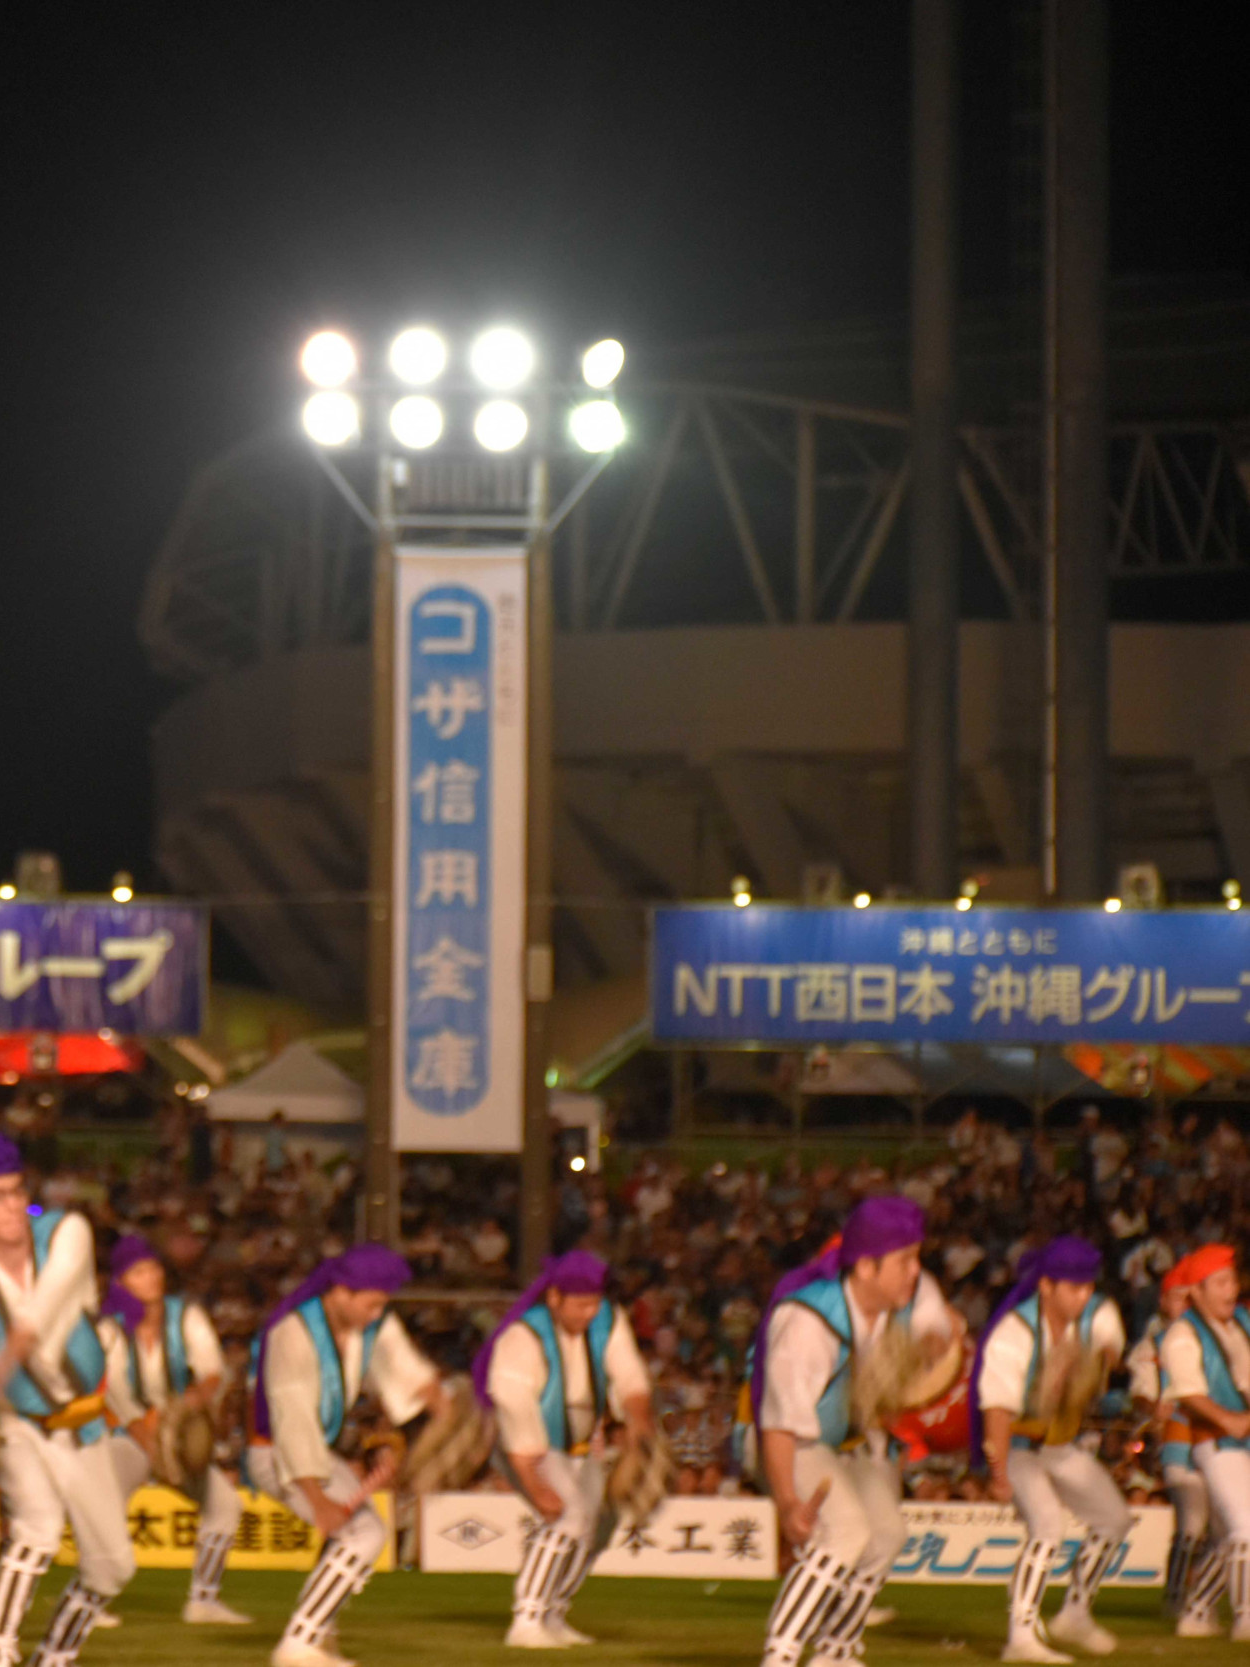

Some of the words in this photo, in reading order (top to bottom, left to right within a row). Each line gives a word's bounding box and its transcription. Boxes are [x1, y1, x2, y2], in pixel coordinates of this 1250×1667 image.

[410, 600, 487, 1099] コザ信用金庫
[899, 926, 1059, 955] 沖縄とともに
[673, 962, 956, 1025] NTT西日本
[969, 962, 1250, 1026] 沖縄グルー
